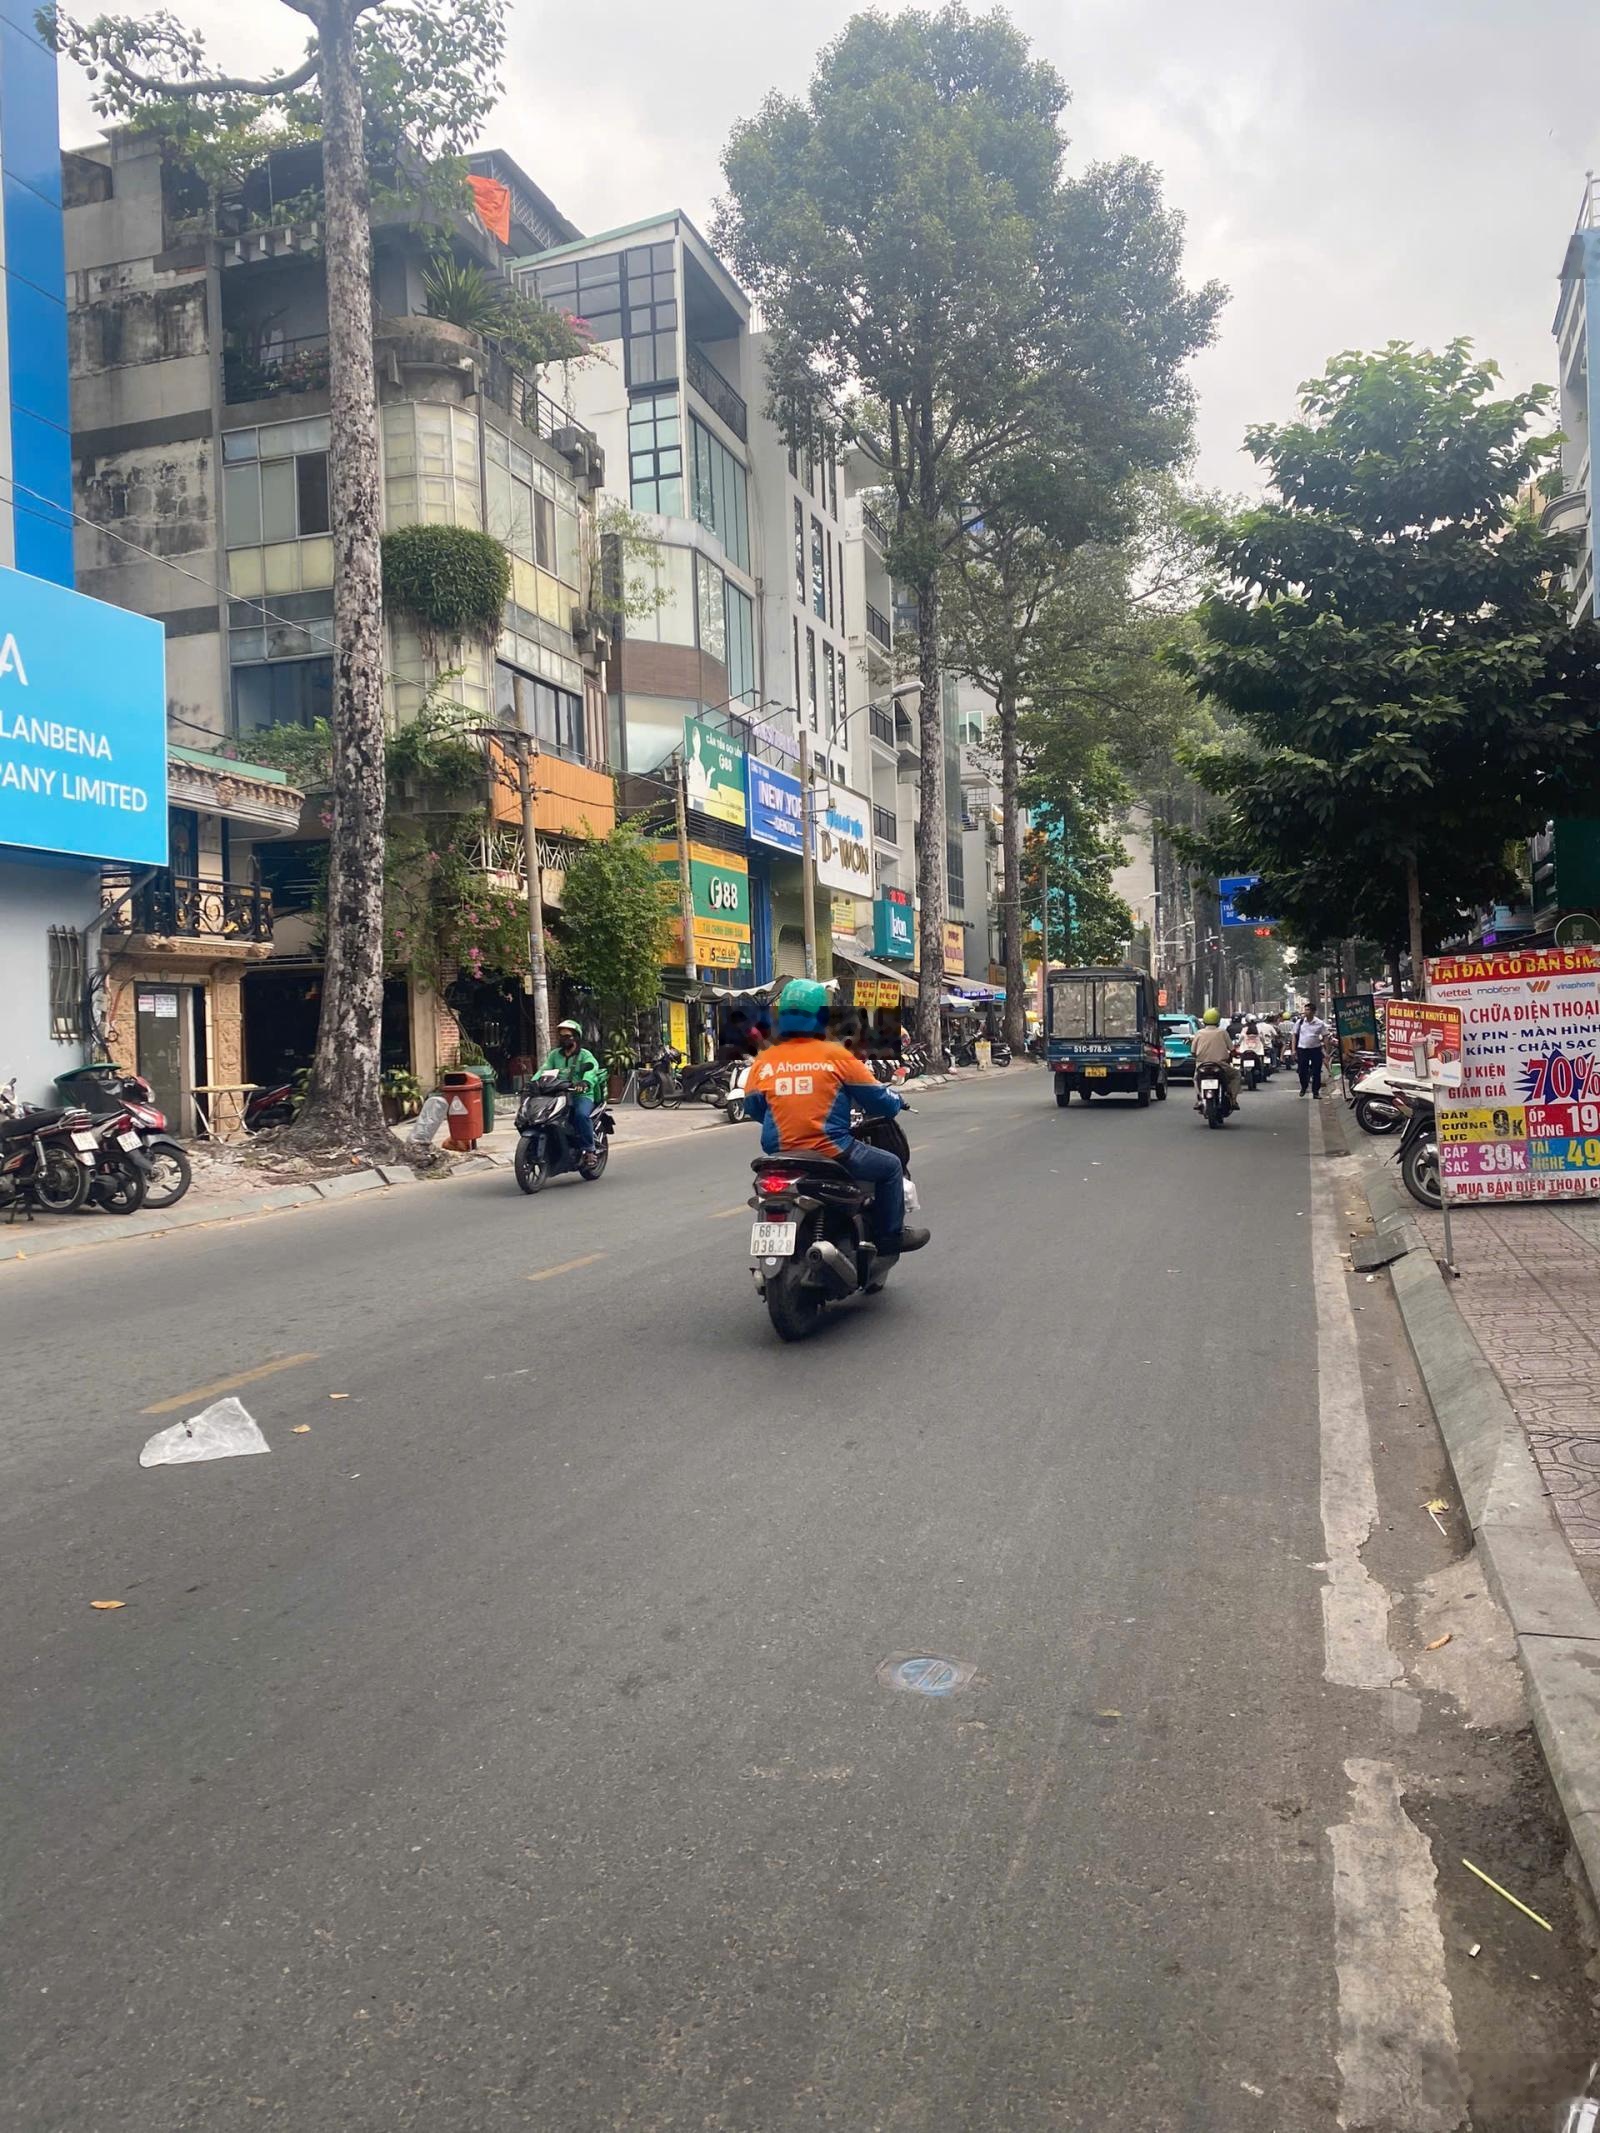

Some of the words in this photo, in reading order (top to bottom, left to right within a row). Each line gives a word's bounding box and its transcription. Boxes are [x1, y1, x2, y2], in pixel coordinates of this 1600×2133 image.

[0, 760, 56, 796] ANY
[62, 772, 148, 812] LIMITED
[758, 780, 785, 812] NEW
[1437, 988, 1472, 998] viettel
[1477, 985, 1521, 995] mobifone
[1556, 980, 1596, 991] vinaphone
[1470, 1003, 1511, 1024] CHỮA
[1513, 1000, 1550, 1023] ĐIỆN
[1388, 1028, 1407, 1043] SIM
[1482, 1030, 1509, 1041] PIN
[1521, 1025, 1557, 1038] MÀN
[1466, 1044, 1506, 1056] KÍNH
[1517, 1040, 1562, 1053] CHÂN
[1566, 1038, 1597, 1050] SẠC
[776, 1061, 836, 1073] Ahamove
[1475, 1062, 1506, 1079] KIỆN
[1526, 1054, 1600, 1101] 70%
[1529, 1106, 1546, 1123] ỐP
[1529, 1123, 1564, 1138] LƯNG
[1531, 1141, 1549, 1155] TAI
[1478, 1144, 1527, 1172] 39K
[1532, 1156, 1566, 1170] NGHE
[1445, 1160, 1470, 1176] SẠC
[1456, 1183, 1484, 1195] MUA
